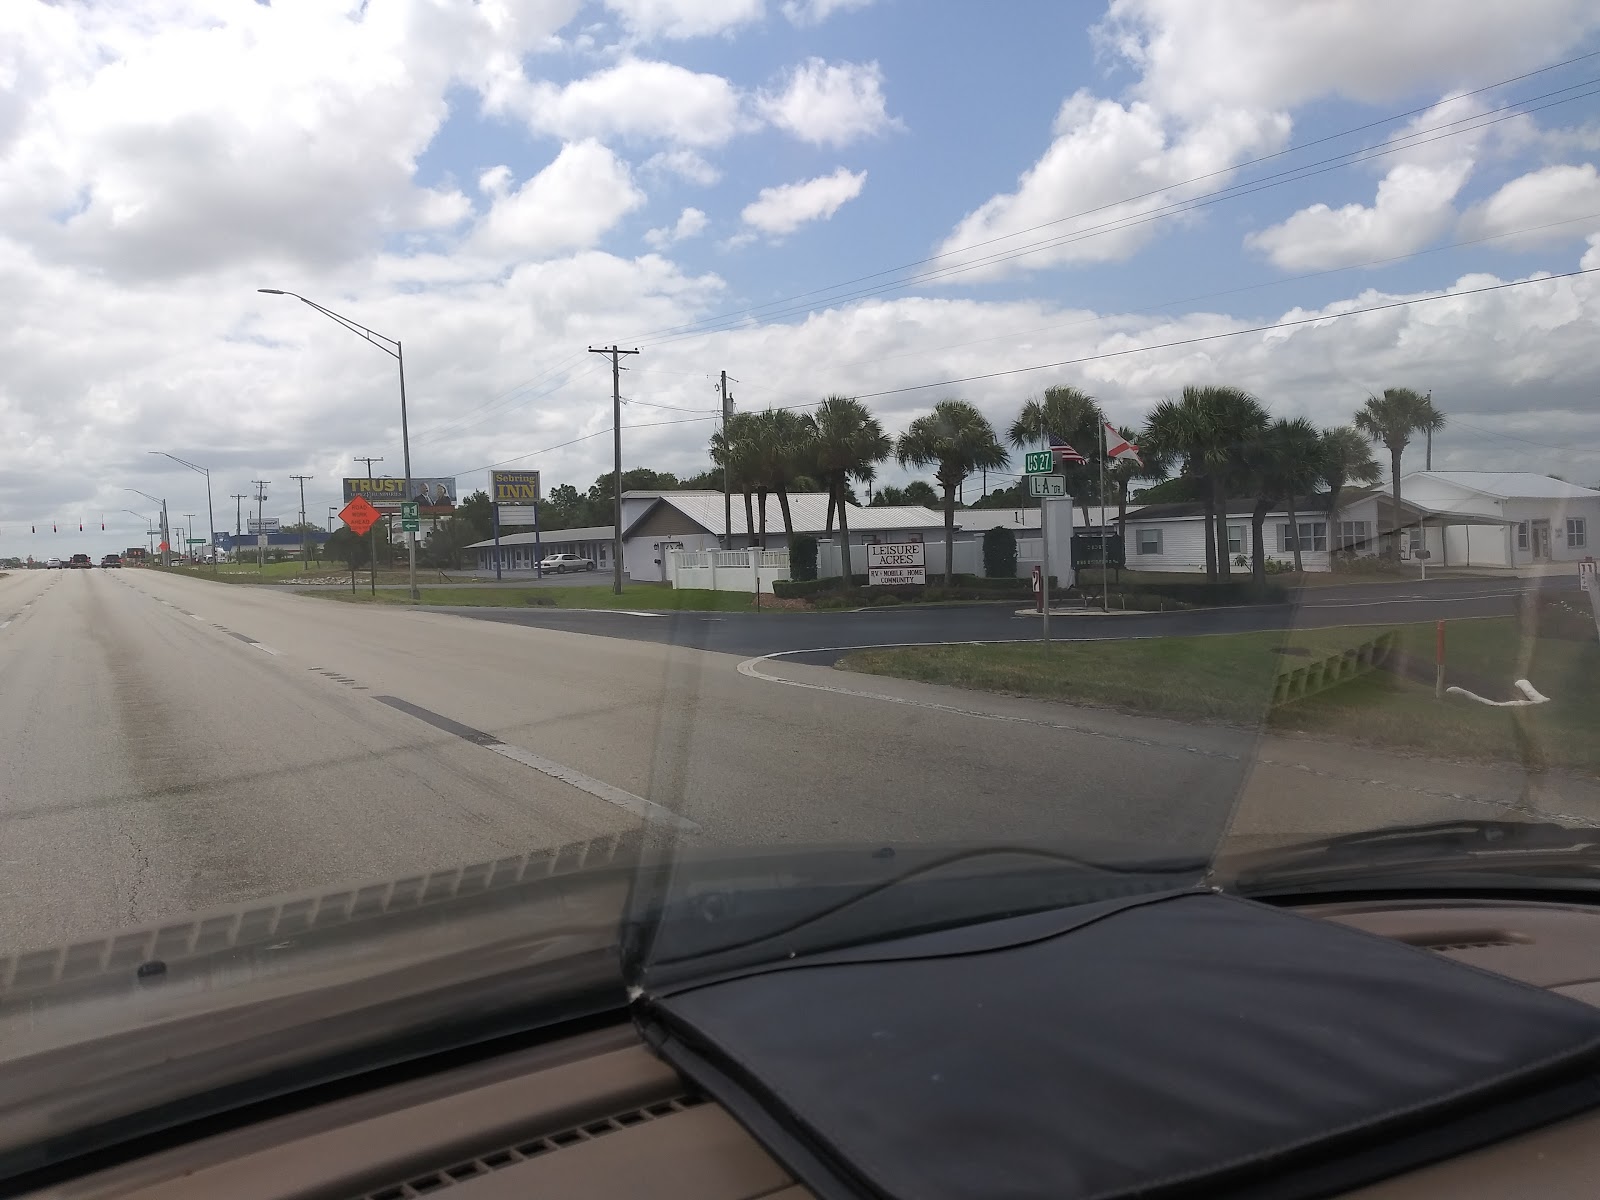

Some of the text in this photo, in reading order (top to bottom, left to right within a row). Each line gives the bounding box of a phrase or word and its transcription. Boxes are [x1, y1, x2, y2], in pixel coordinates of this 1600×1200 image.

[1028, 454, 1050, 471] US 27
[496, 474, 535, 484] Sebring
[348, 480, 405, 491] TRUST
[497, 484, 535, 498] INN
[872, 545, 919, 555] LEISURE
[879, 555, 914, 565] ACRES
